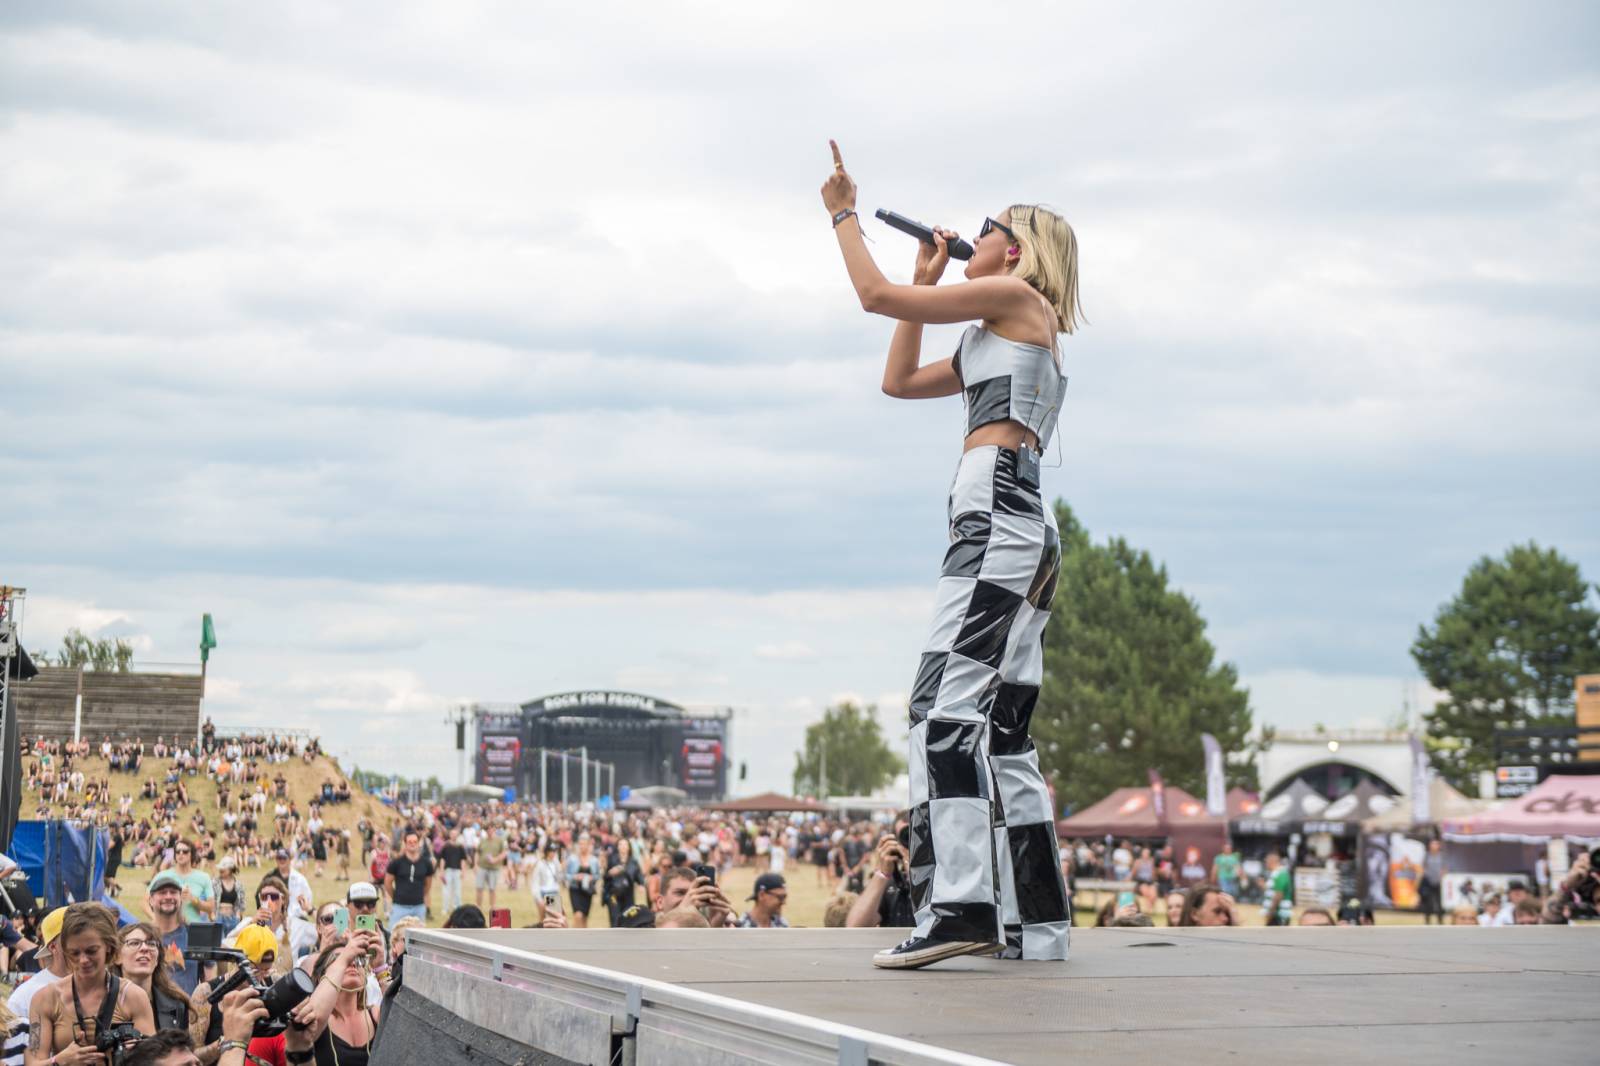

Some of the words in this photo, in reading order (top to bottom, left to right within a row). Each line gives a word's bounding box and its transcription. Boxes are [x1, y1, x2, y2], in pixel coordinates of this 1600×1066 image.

[544, 694, 579, 711] ROCK
[580, 691, 606, 705] FOR
[607, 692, 656, 712] PEOPLE
